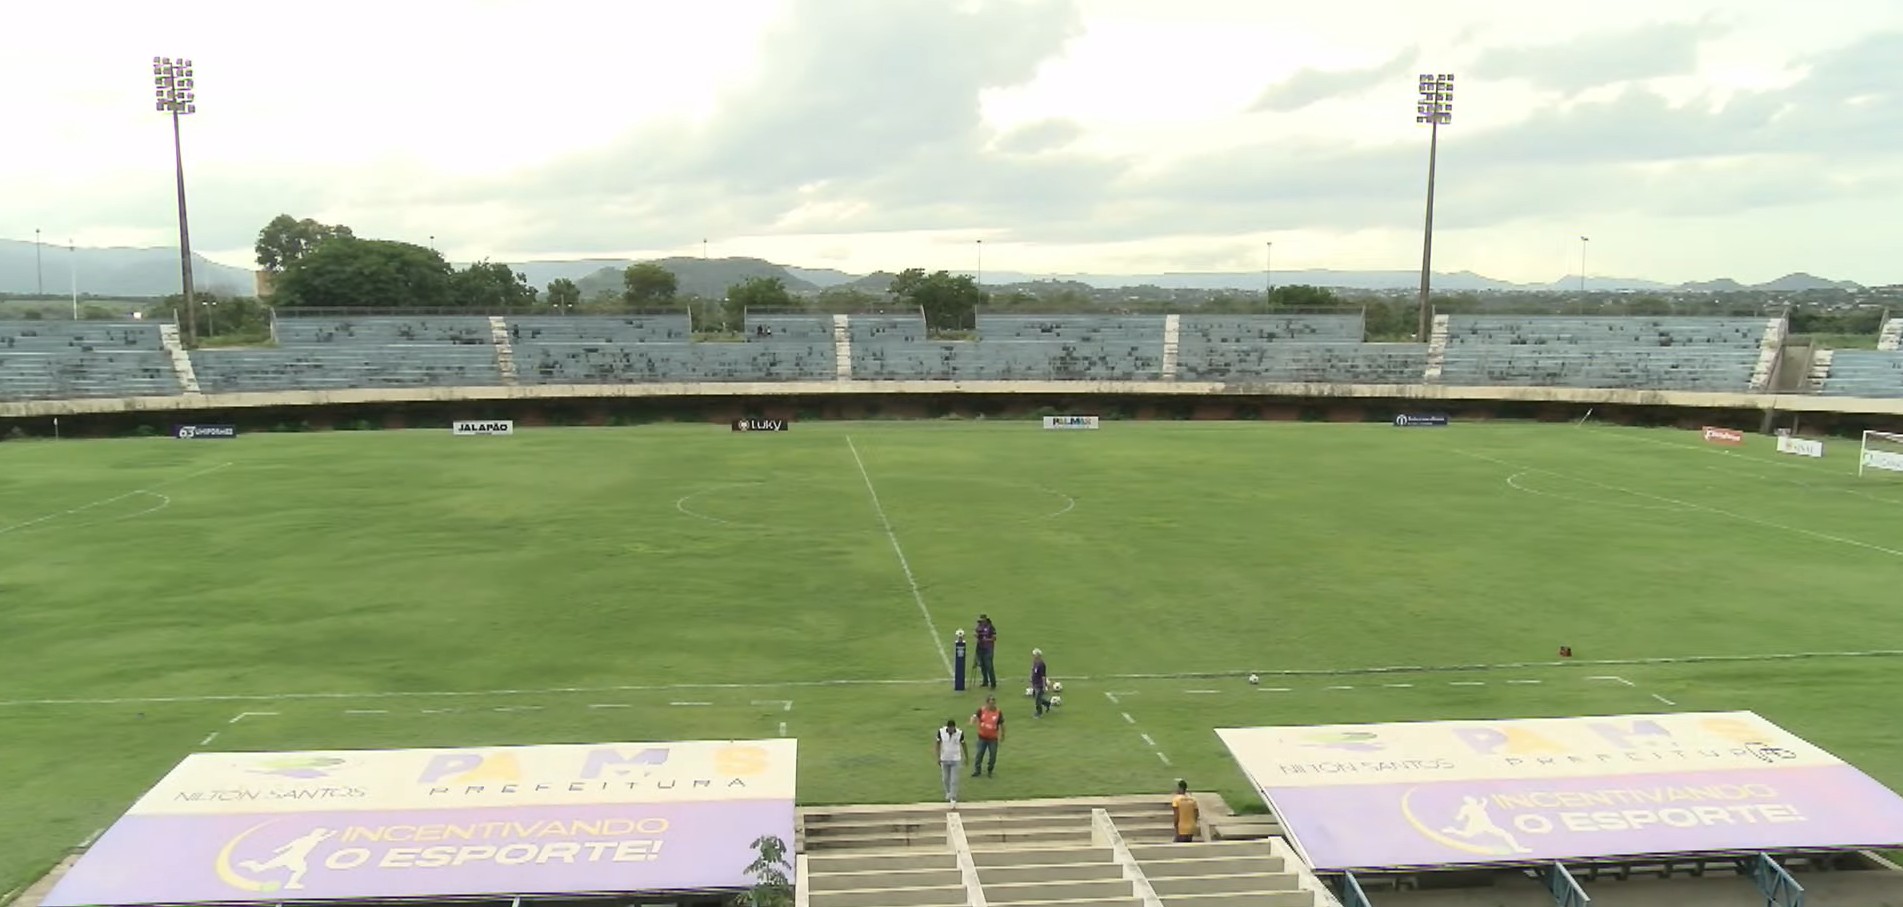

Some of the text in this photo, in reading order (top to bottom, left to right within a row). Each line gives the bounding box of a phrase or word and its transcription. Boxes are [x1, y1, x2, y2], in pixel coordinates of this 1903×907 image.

[458, 423, 508, 431] JALAPÃO
[1279, 758, 1455, 775] NILTON SANTOS
[174, 788, 366, 801] NILTON SANTOS
[429, 777, 747, 795] PREFEITURA
[1491, 783, 1778, 809] INCENTIVANDO
[1514, 804, 1807, 833] O ESPORTE!
[339, 818, 670, 842] INCENTIVANDO
[325, 840, 662, 869] O ESPORTE!
